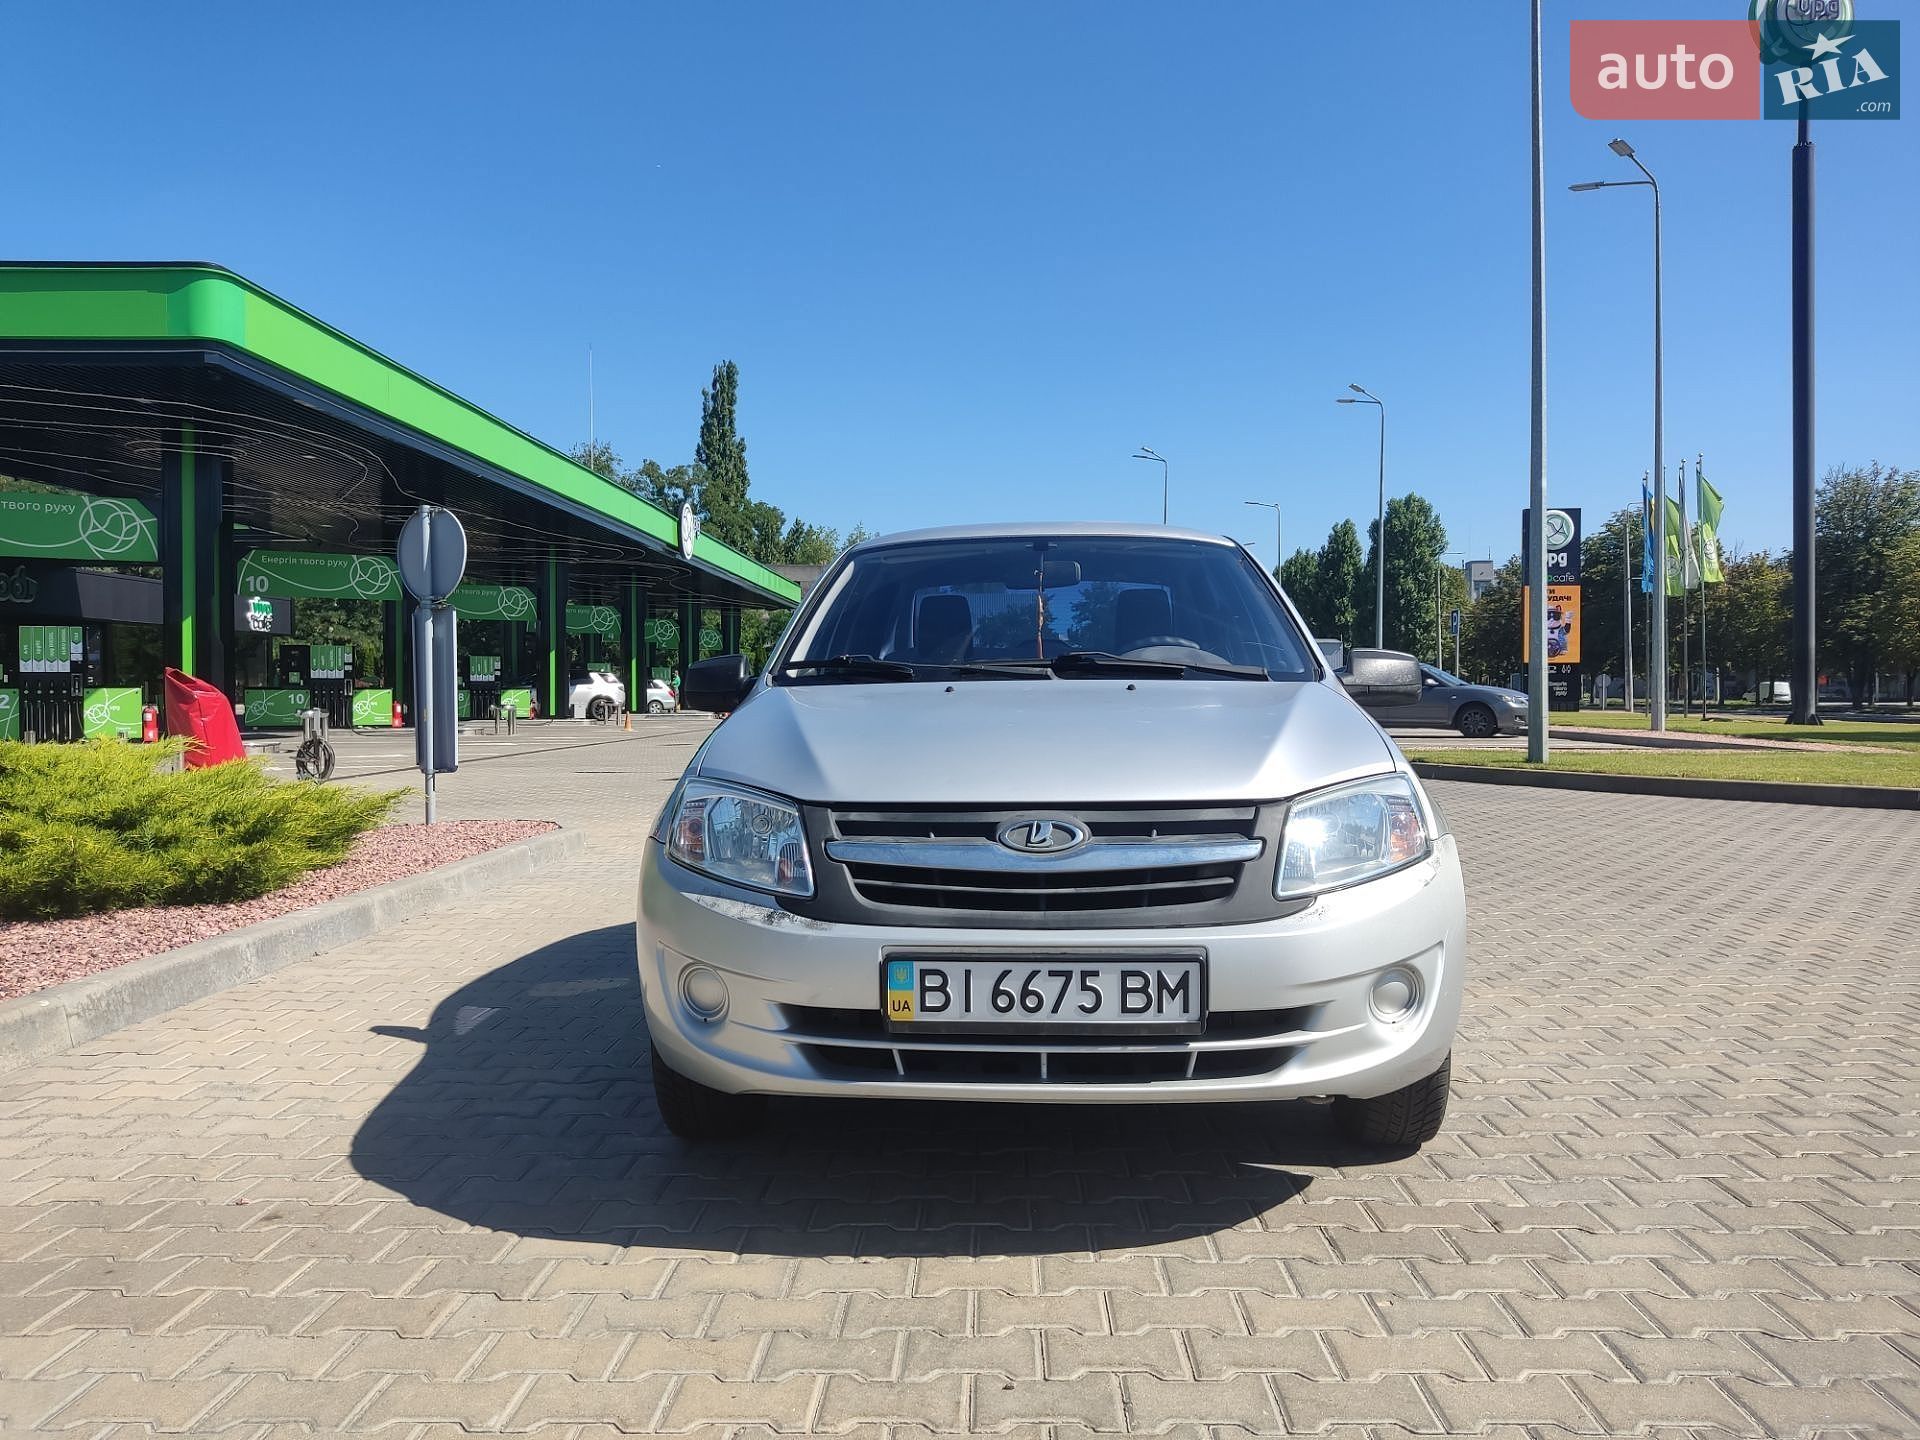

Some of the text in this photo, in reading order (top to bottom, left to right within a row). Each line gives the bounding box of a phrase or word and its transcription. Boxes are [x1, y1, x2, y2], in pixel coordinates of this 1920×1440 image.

[1, 501, 75, 515] твого руху
[327, 560, 348, 569] руху
[1548, 553, 1568, 567] pg
[246, 576, 269, 593] 10
[288, 693, 304, 704] 10
[919, 968, 1190, 1014] BI 6675 BM
[892, 1000, 911, 1012] UA
